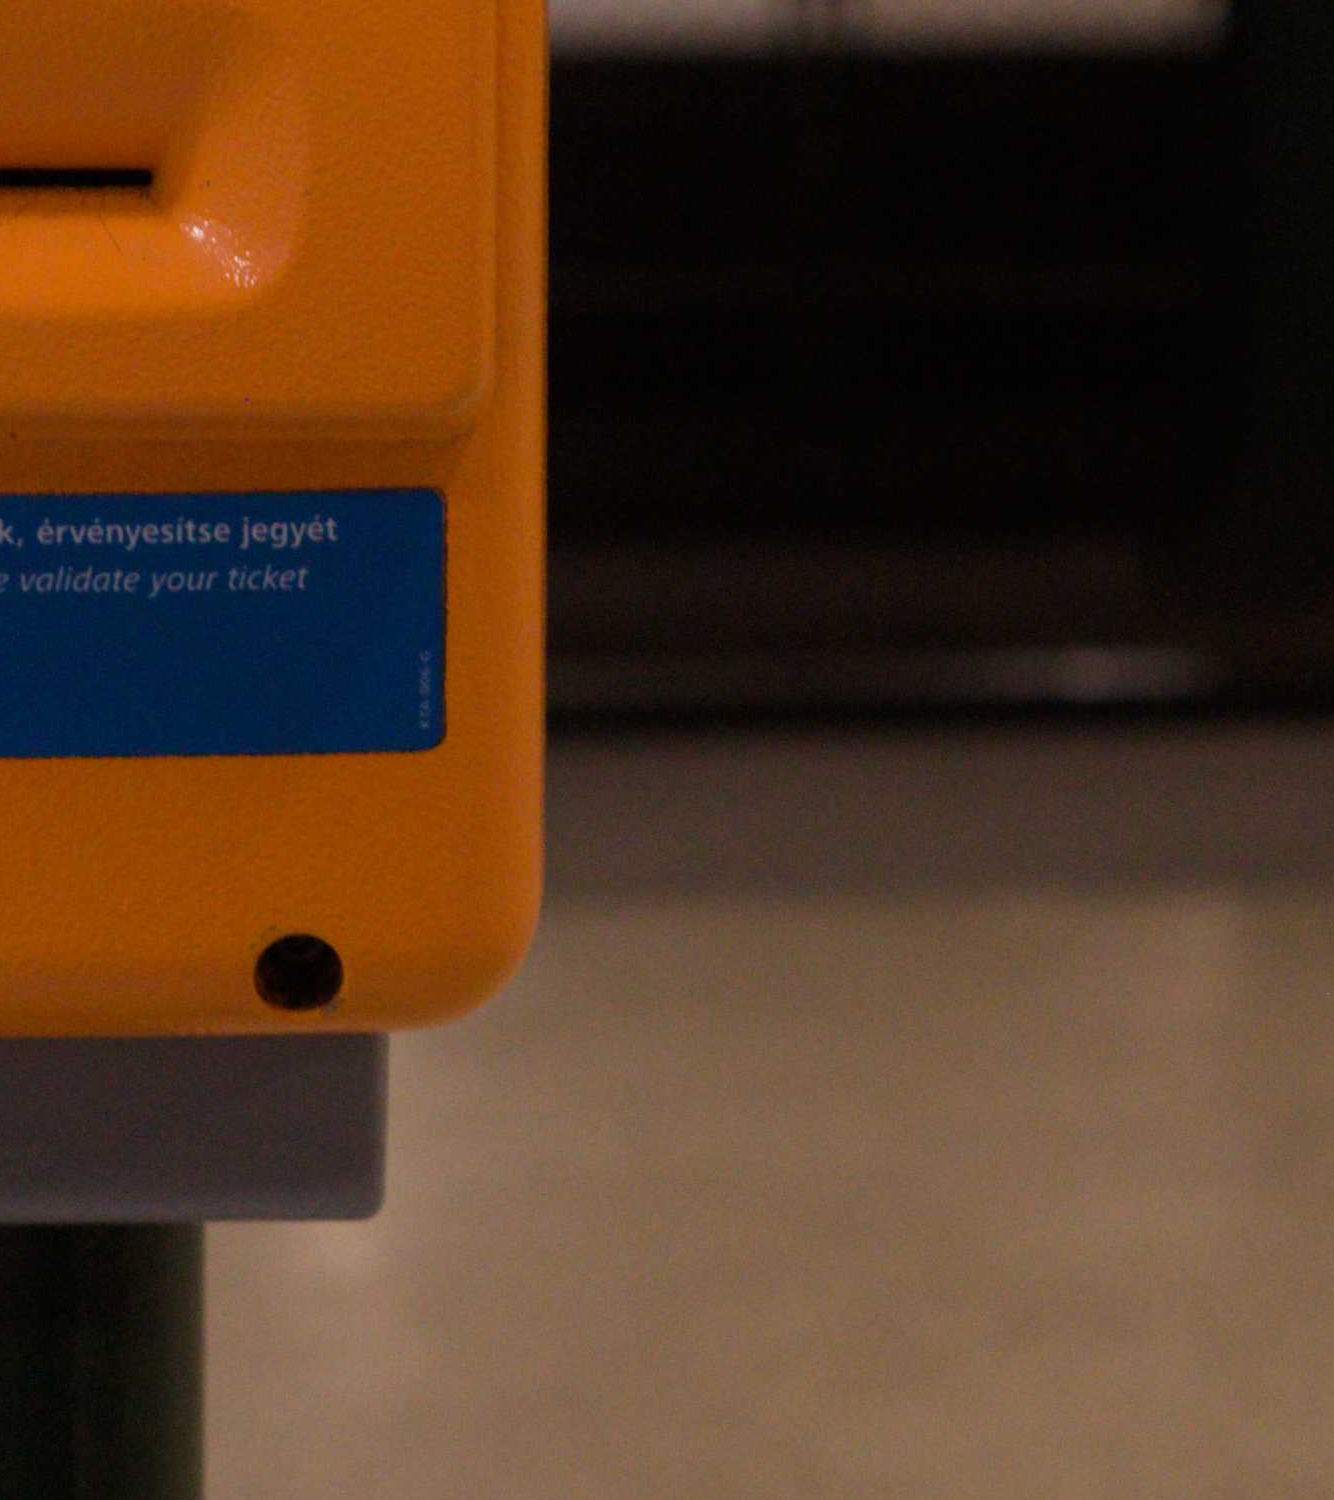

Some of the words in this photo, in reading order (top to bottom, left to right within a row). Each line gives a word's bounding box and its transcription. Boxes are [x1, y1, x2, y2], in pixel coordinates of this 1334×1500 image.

[36, 518, 231, 551] érvényesítse
[239, 516, 339, 549] jegyét
[20, 566, 140, 593] validate
[147, 573, 219, 599] your
[227, 565, 310, 591] ticket
